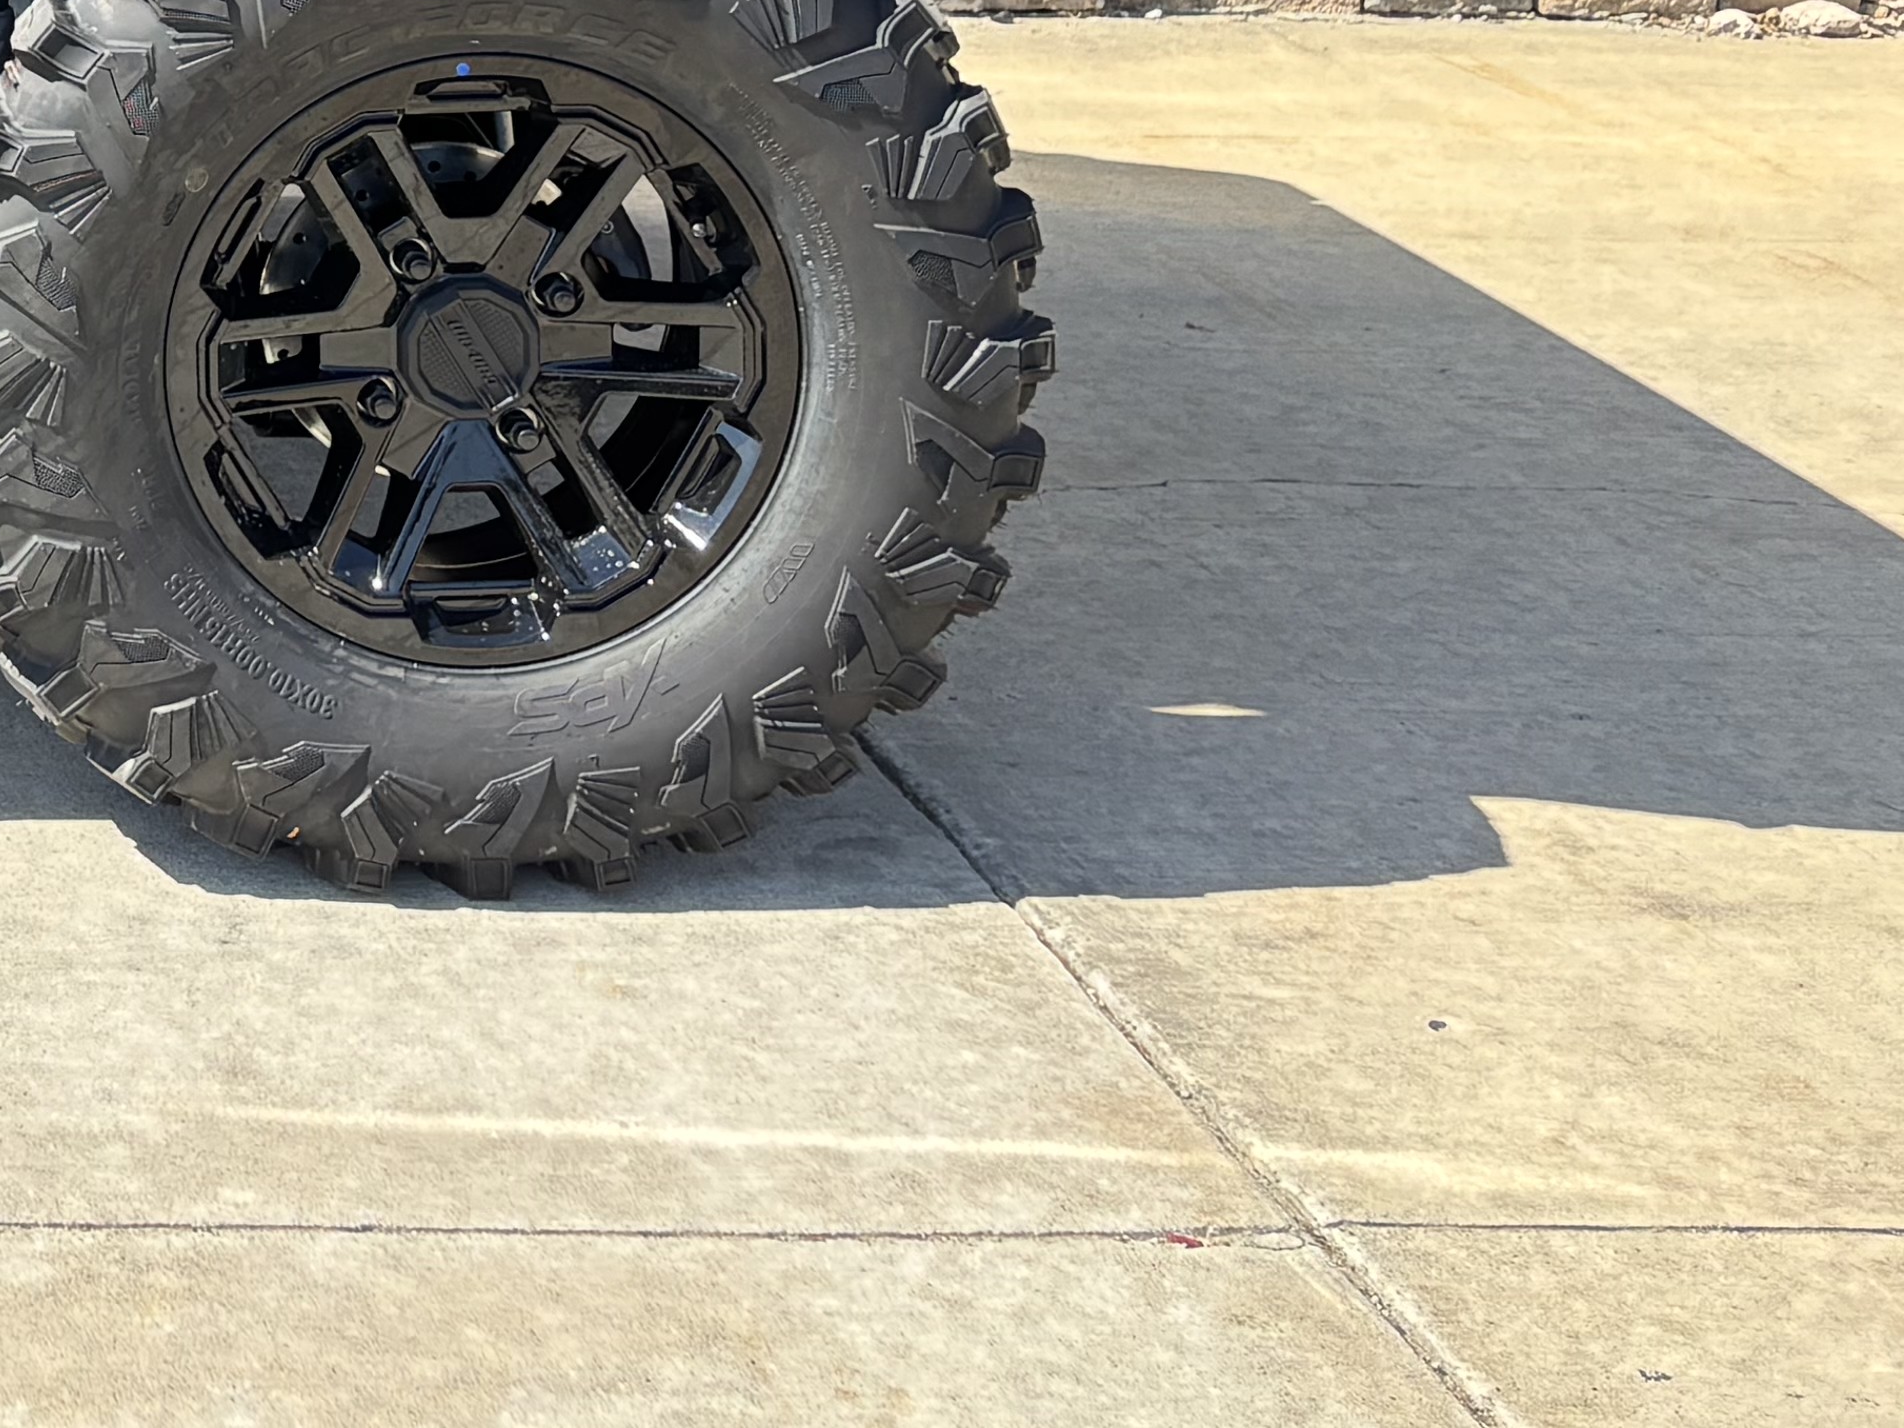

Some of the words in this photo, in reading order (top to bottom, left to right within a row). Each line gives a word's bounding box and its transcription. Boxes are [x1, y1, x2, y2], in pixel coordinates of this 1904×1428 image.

[412, 1, 677, 56] FORCE
[163, 573, 213, 623] NHS
[507, 638, 680, 734] XPS
